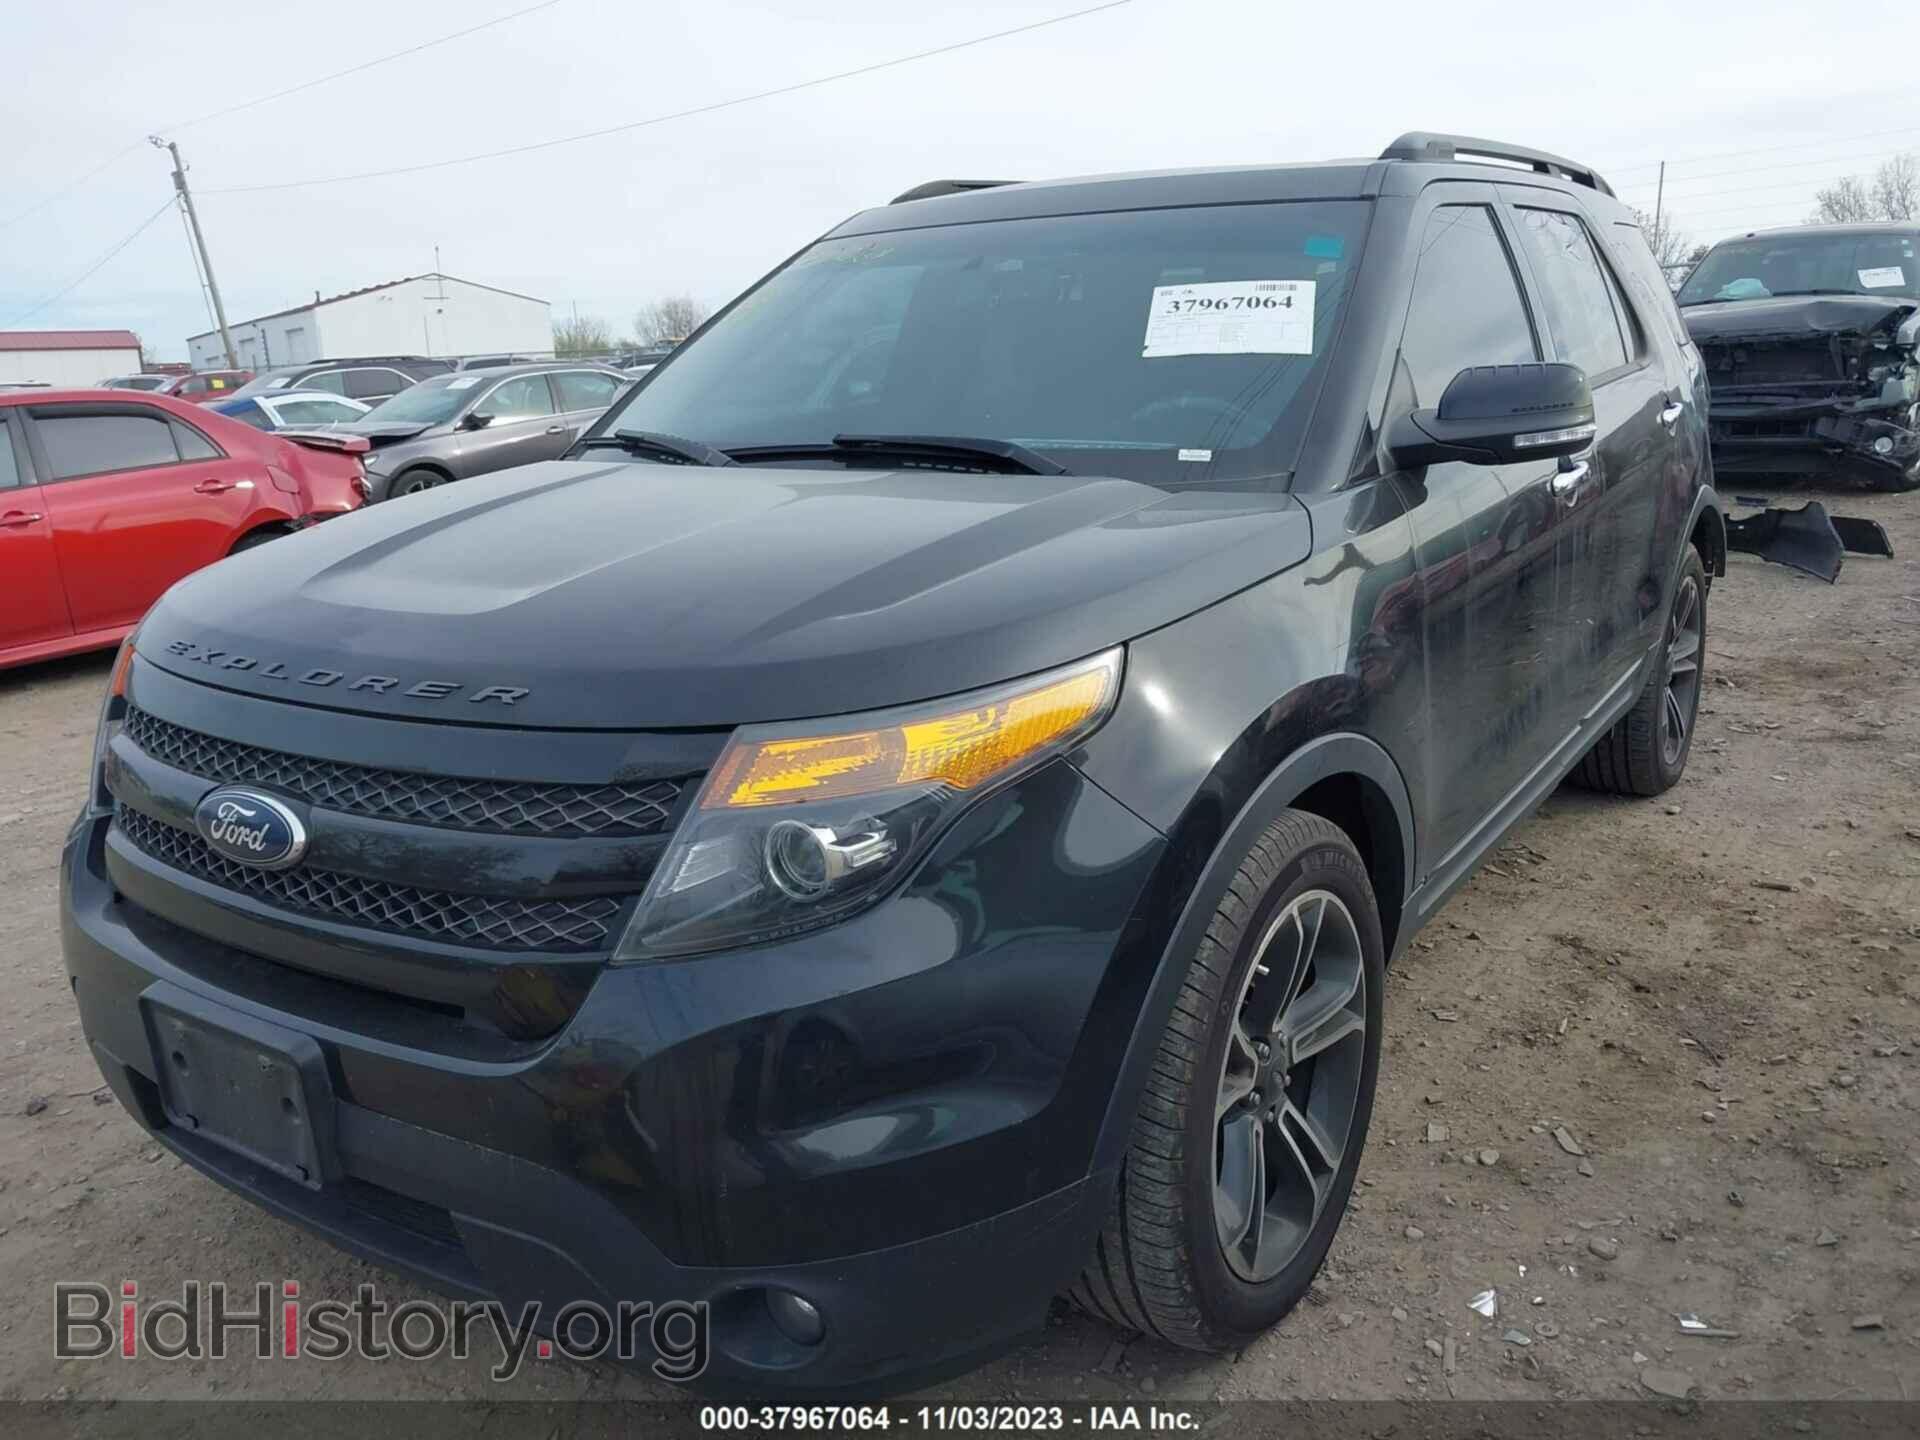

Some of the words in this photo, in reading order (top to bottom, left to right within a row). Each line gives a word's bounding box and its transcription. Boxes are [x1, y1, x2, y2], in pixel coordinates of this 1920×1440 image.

[1166, 295, 1293, 314] 37967064
[165, 640, 530, 705] EXPLORER
[210, 801, 271, 852] Ford
